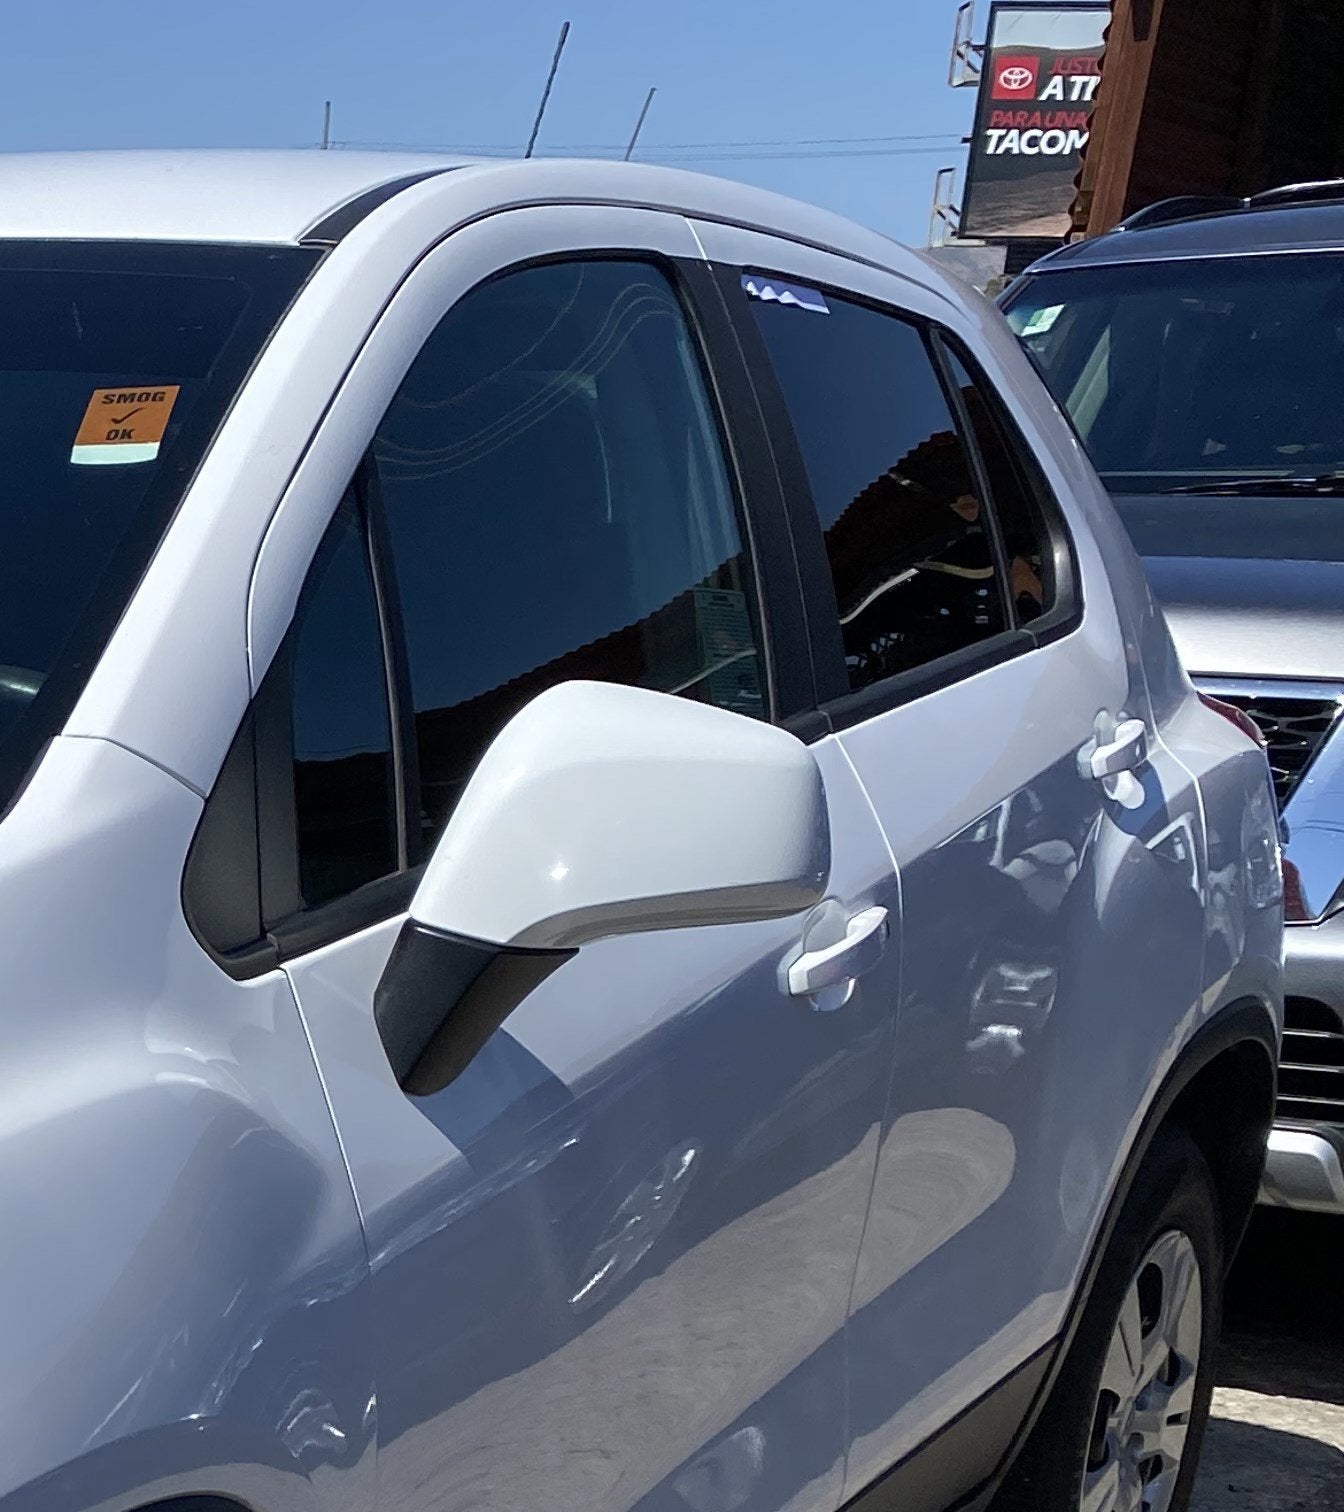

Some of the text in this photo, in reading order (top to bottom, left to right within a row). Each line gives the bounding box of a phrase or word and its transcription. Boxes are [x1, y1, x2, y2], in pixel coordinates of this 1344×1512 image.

[1070, 75, 1101, 101] TI
[102, 391, 166, 404] SMOG
[105, 428, 135, 441] OK
